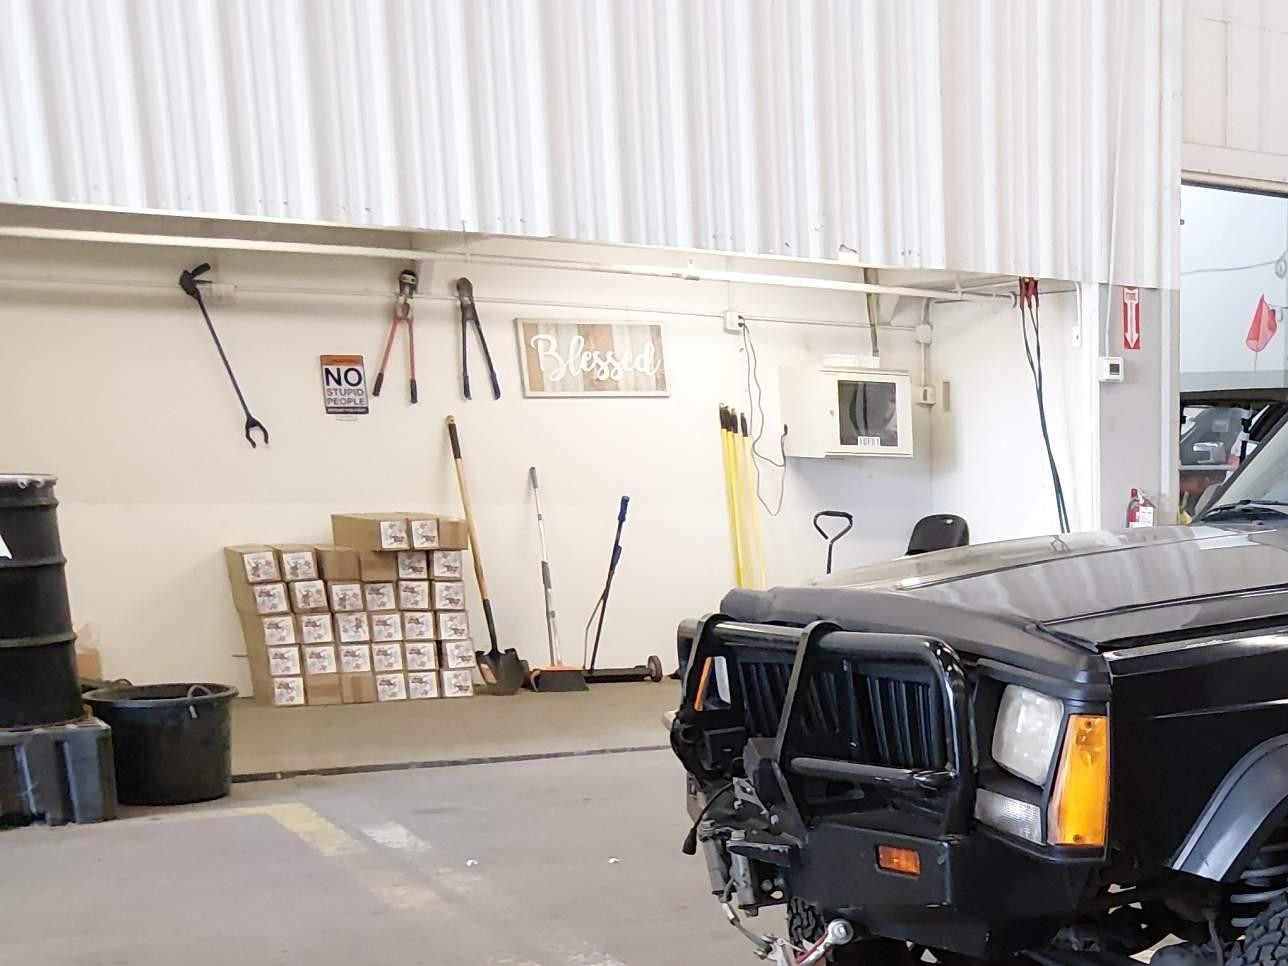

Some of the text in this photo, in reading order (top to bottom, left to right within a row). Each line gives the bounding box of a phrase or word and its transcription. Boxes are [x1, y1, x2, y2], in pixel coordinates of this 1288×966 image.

[530, 334, 661, 382] Blessed
[324, 367, 362, 386] NO
[326, 388, 364, 397] STUPID
[326, 397, 366, 406] PEOPLE
